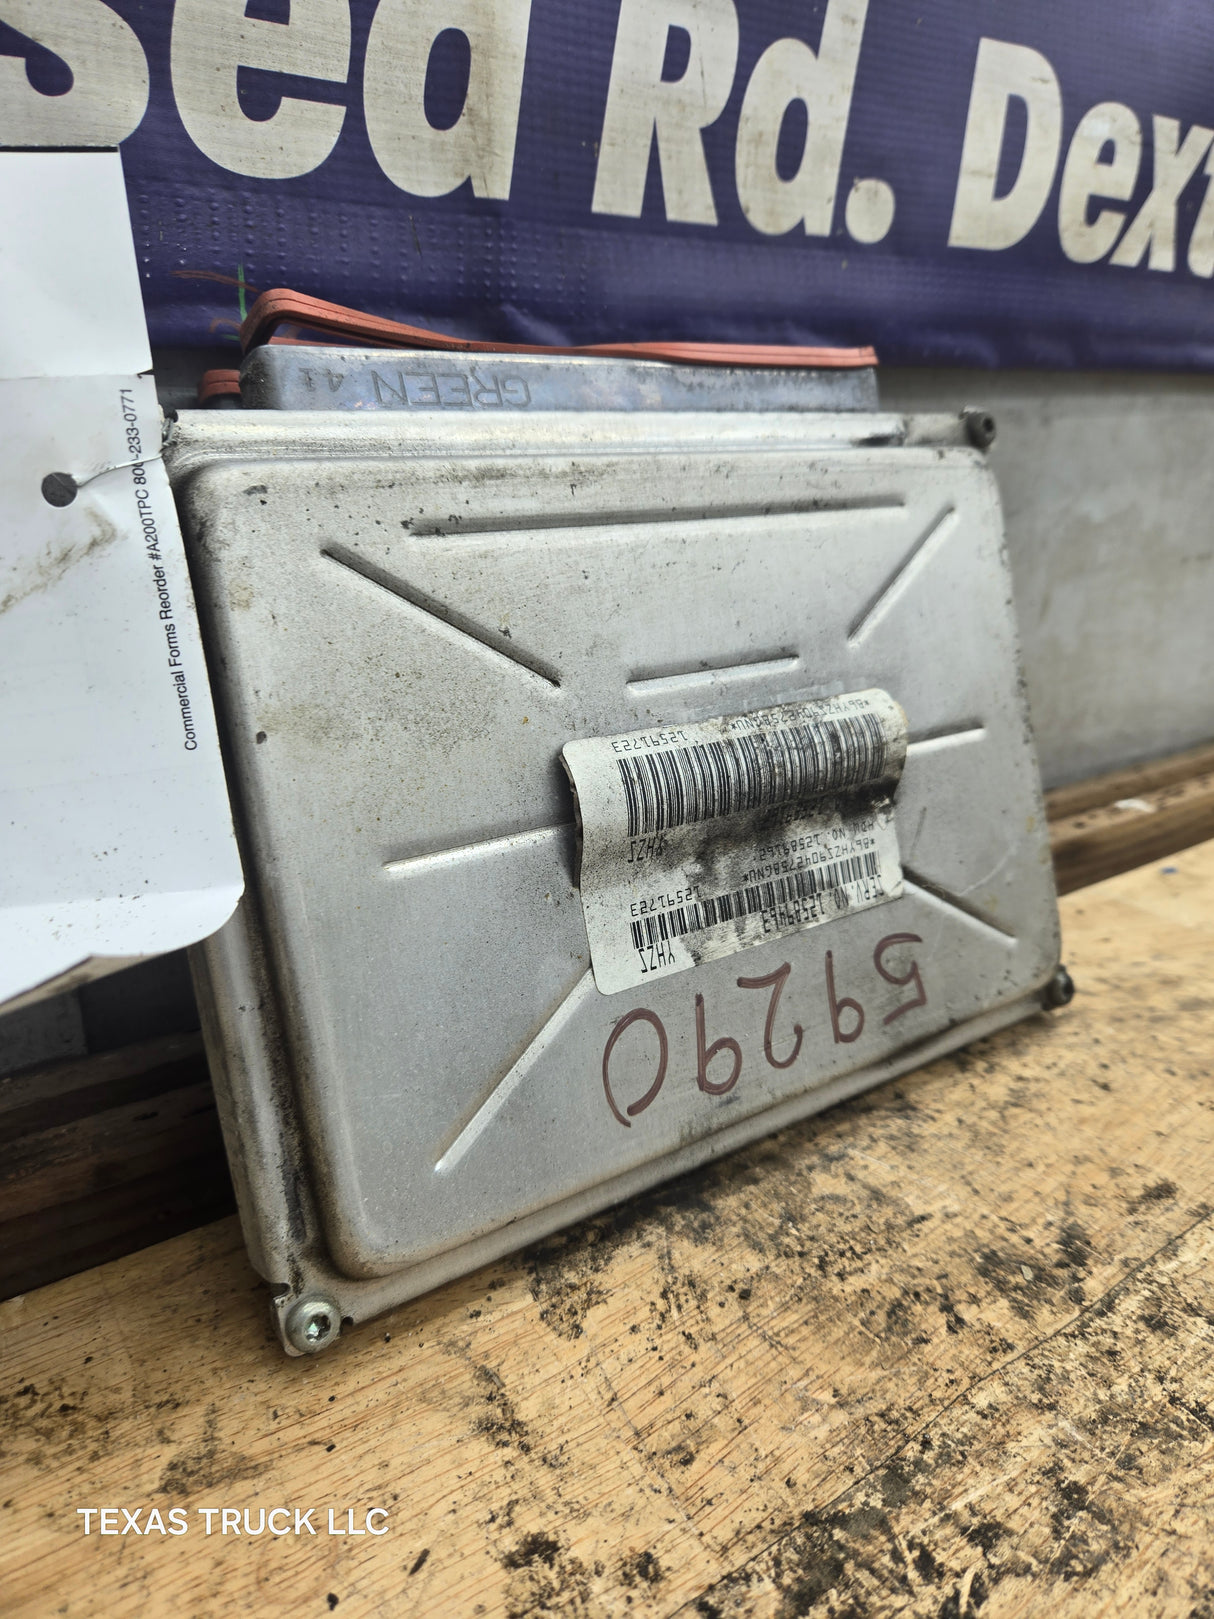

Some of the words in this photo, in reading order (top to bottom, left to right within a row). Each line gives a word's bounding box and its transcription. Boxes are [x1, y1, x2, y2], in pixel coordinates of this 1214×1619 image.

[591, 0, 895, 243] Rd.
[371, 369, 532, 408] GREEN
[120, 388, 148, 487] 800-233-0771
[134, 488, 163, 561] #A200TPC
[152, 563, 174, 620] Reorder
[160, 622, 183, 668] Forms
[172, 669, 198, 751] Commercial
[611, 730, 688, 753] 12591723
[629, 884, 701, 917] 12591723
[602, 933, 927, 1127] 59290
